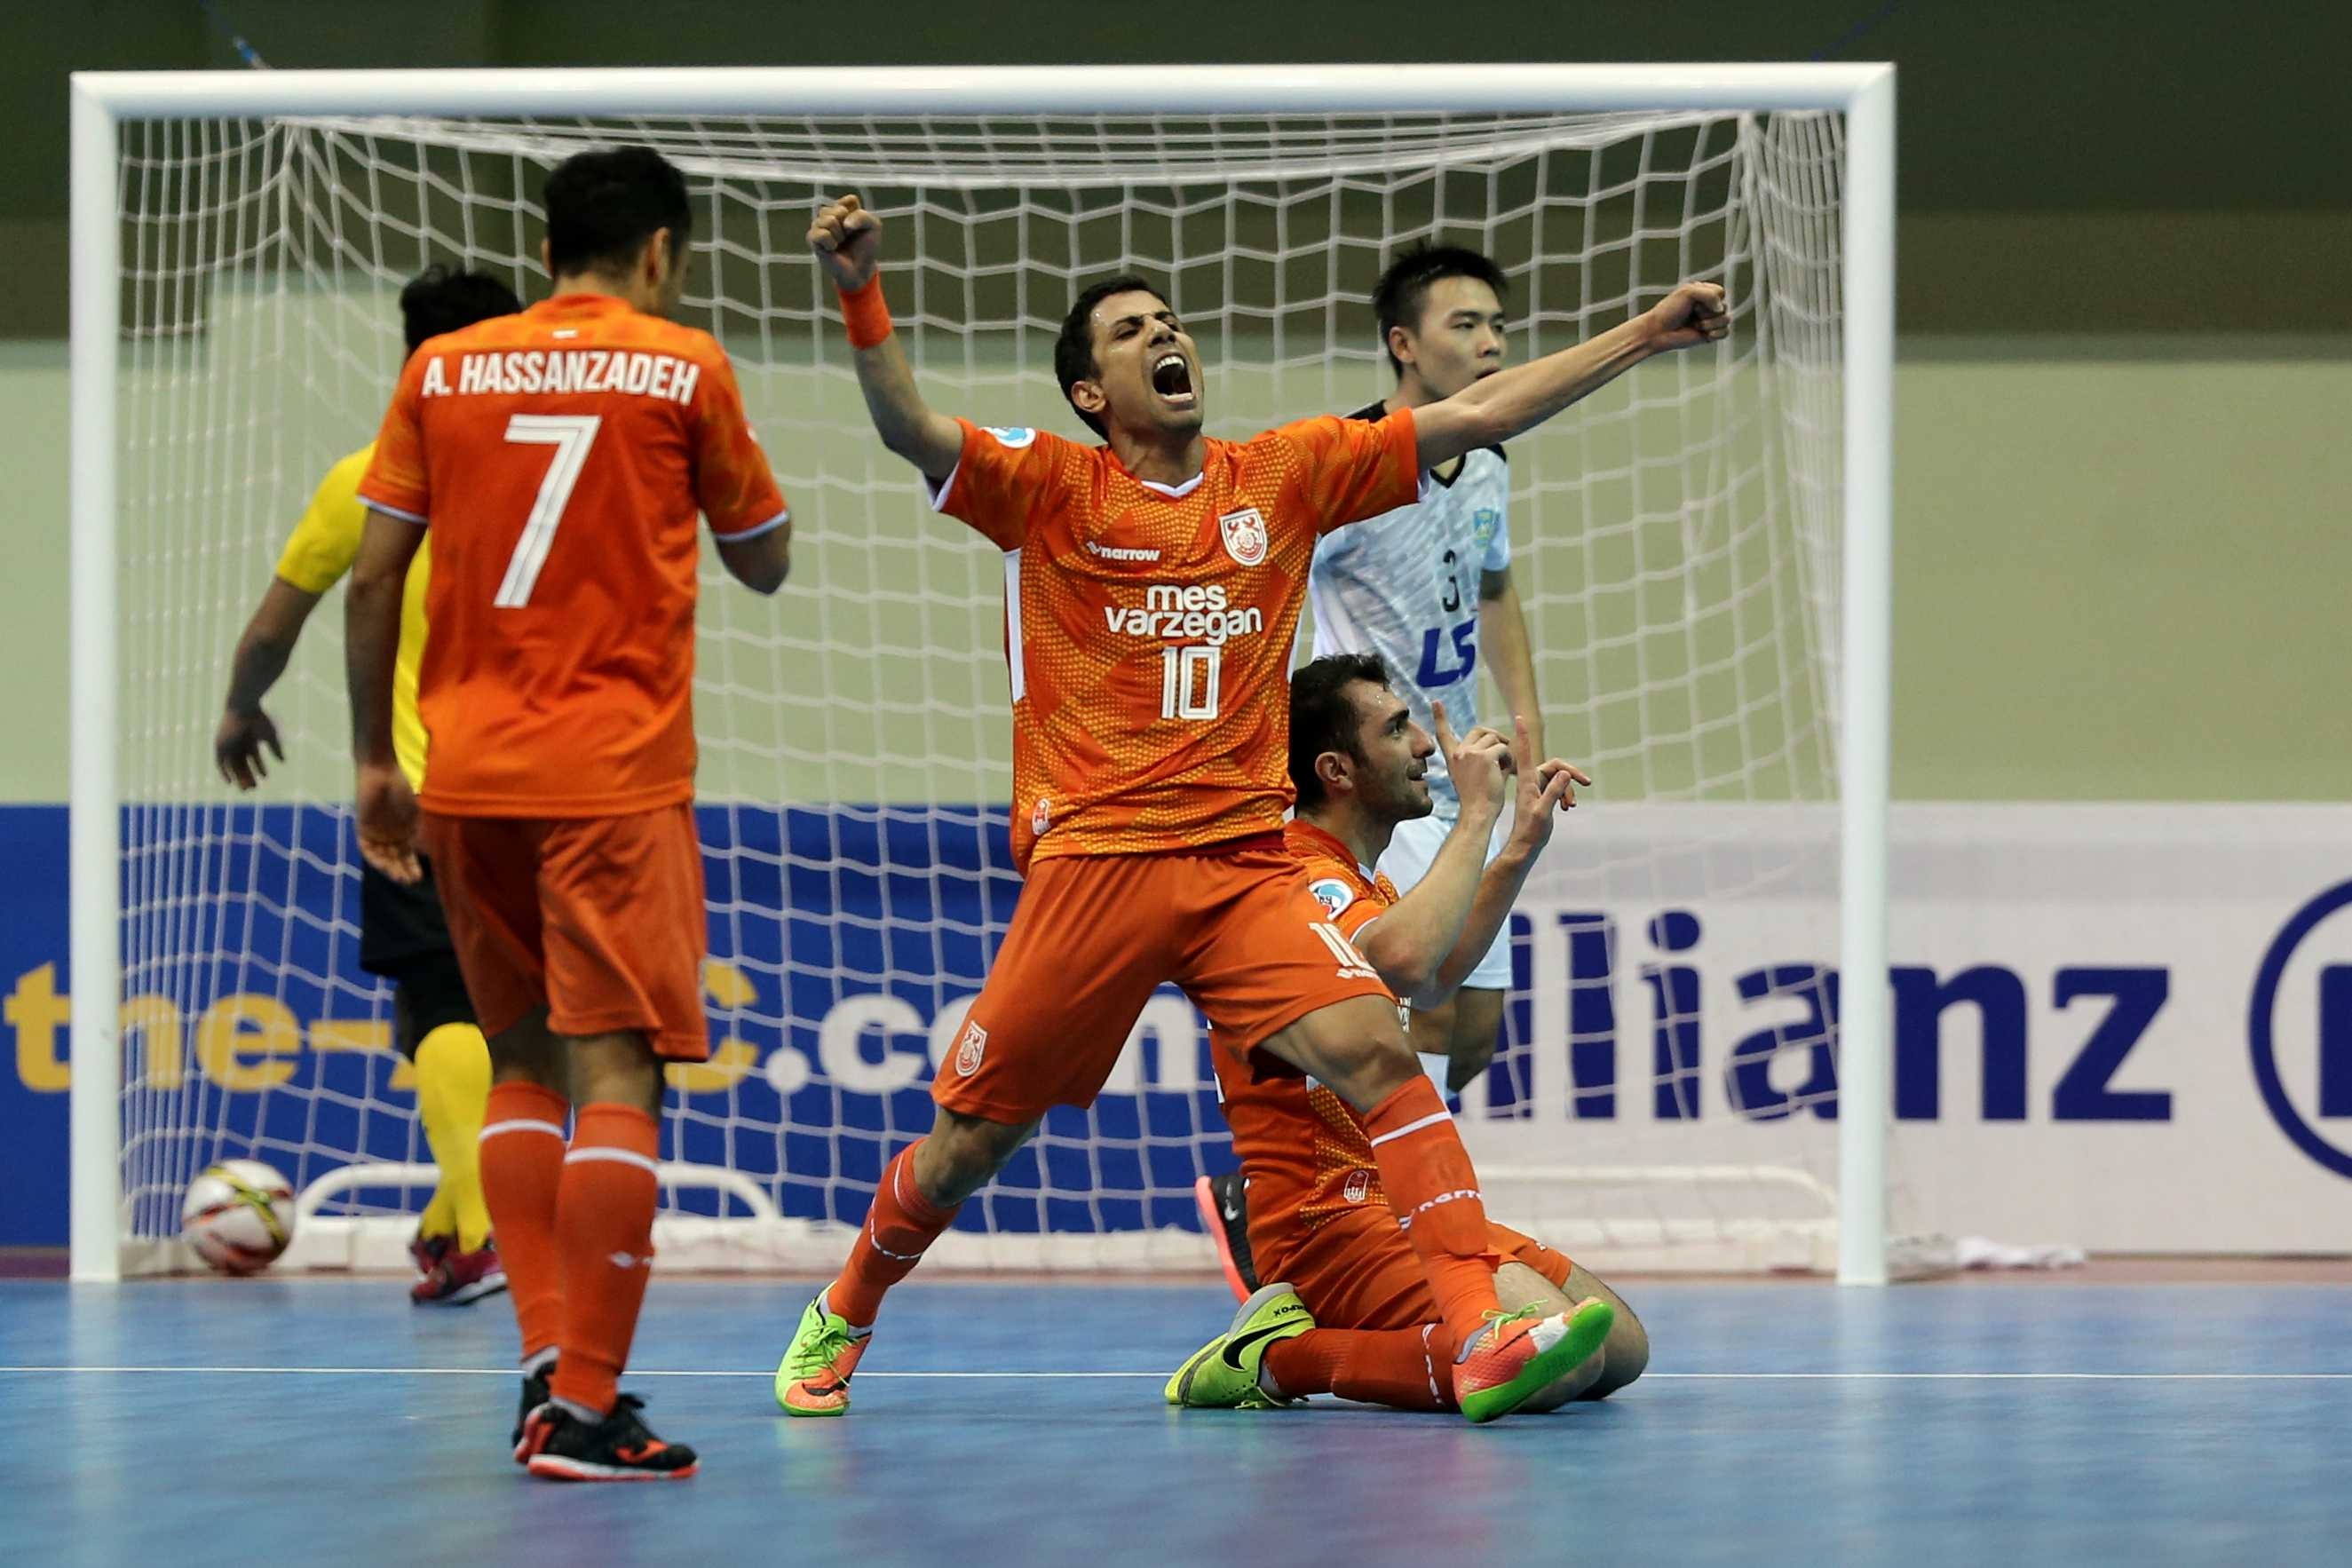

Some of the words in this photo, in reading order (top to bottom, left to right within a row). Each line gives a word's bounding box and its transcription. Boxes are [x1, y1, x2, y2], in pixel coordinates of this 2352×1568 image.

[421, 356, 451, 398] A.
[459, 351, 701, 406] HASSANZADEH
[493, 413, 602, 609] 7
[1100, 546, 1160, 562] narrow
[1146, 584, 1227, 611] mes
[1105, 606, 1263, 646] varzegan
[1160, 645, 1221, 720] 10
[1448, 910, 2173, 1121] llianz
